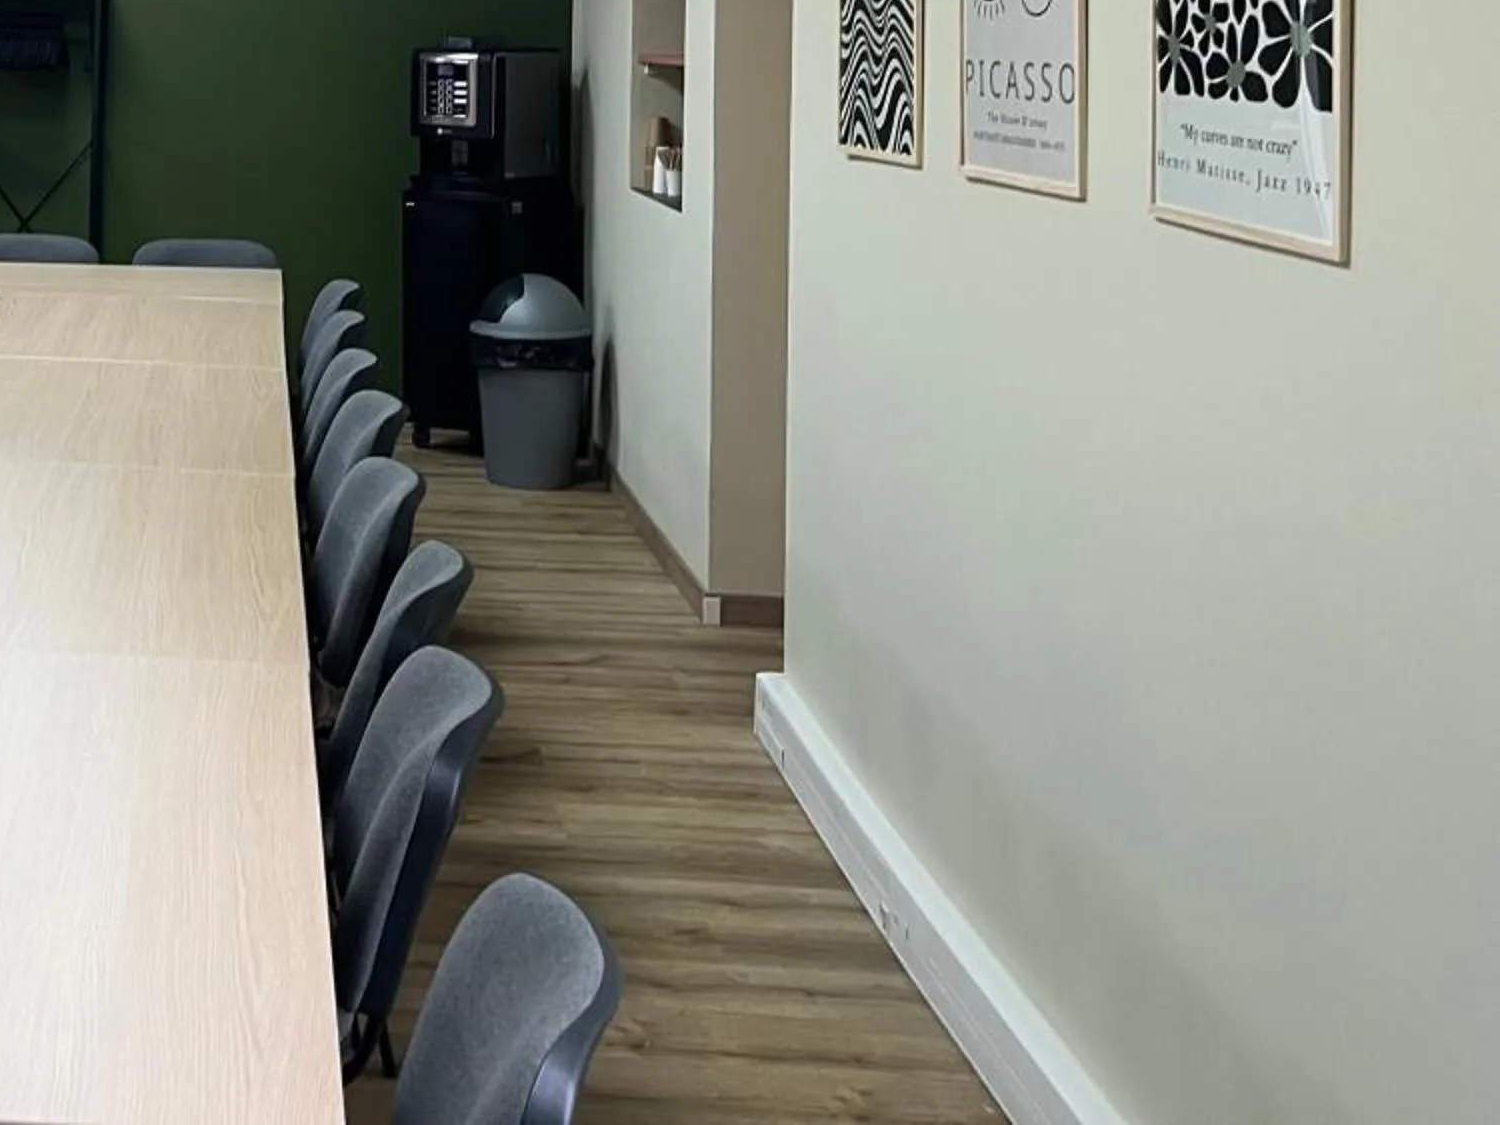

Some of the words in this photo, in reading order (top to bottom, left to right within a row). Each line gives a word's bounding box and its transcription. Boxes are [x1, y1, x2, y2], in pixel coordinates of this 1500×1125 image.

[965, 59, 1075, 104] PICASSO
[1246, 137, 1263, 153] not
[1256, 168, 1287, 194] Jazz
